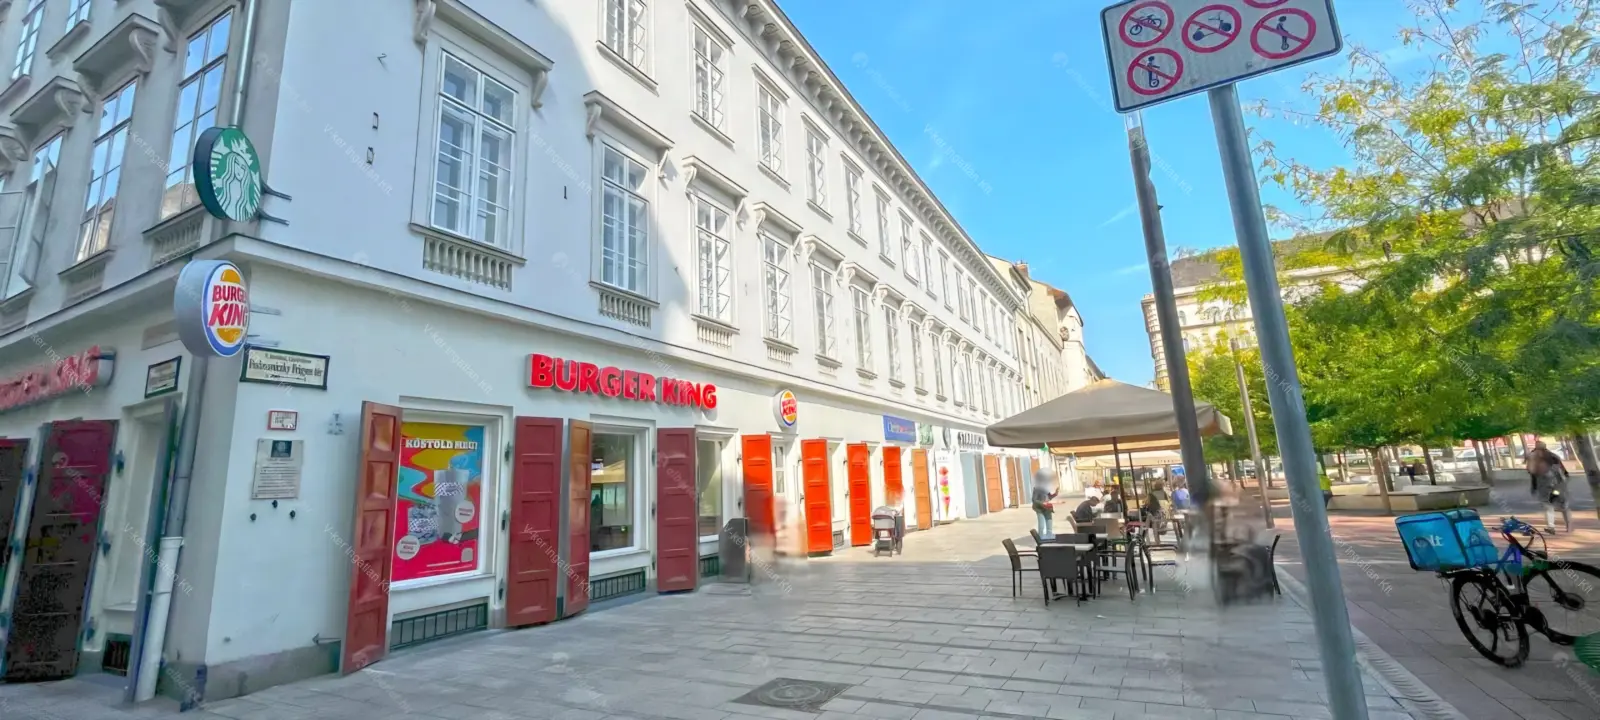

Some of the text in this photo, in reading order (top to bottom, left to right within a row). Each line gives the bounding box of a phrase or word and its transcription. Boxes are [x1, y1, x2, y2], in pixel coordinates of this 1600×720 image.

[212, 284, 247, 303] BURGE
[208, 303, 249, 327] KING
[529, 353, 717, 409] BURGER KING
